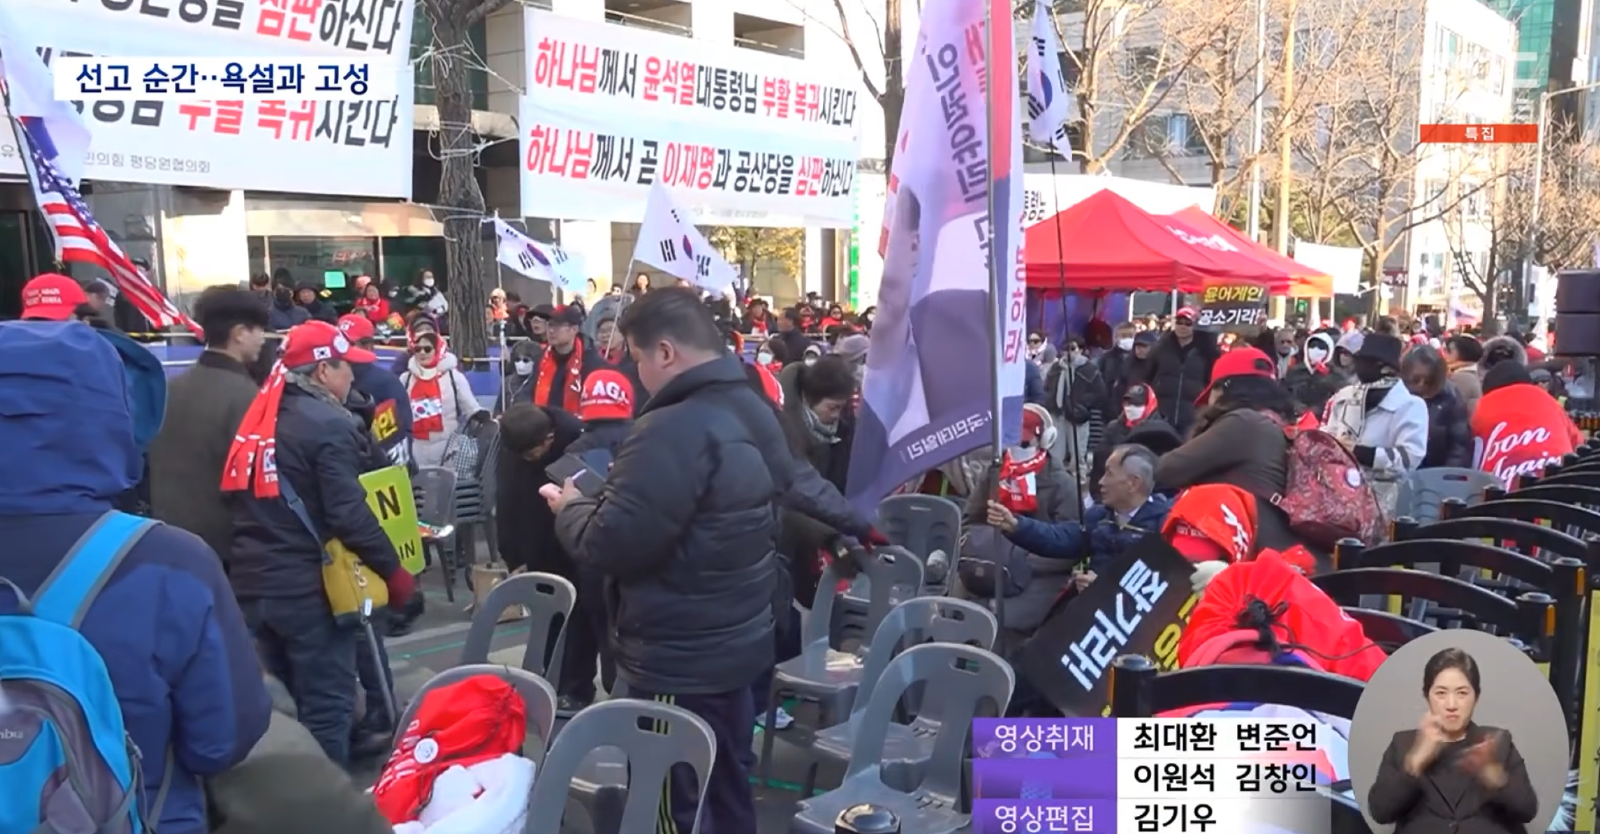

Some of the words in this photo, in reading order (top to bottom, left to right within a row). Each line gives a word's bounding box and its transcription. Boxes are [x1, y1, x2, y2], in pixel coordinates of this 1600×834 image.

[535, 36, 639, 98] 하나님께서
[643, 56, 758, 114] 윤석열대통령님
[763, 75, 791, 119] 부활
[794, 81, 857, 127] 복귀시킨다
[526, 123, 634, 183] 하나님께서
[637, 139, 659, 186] 곧
[662, 142, 732, 190] 이재명과
[733, 150, 795, 195] 공산당을
[794, 155, 854, 198] 심판하신다
